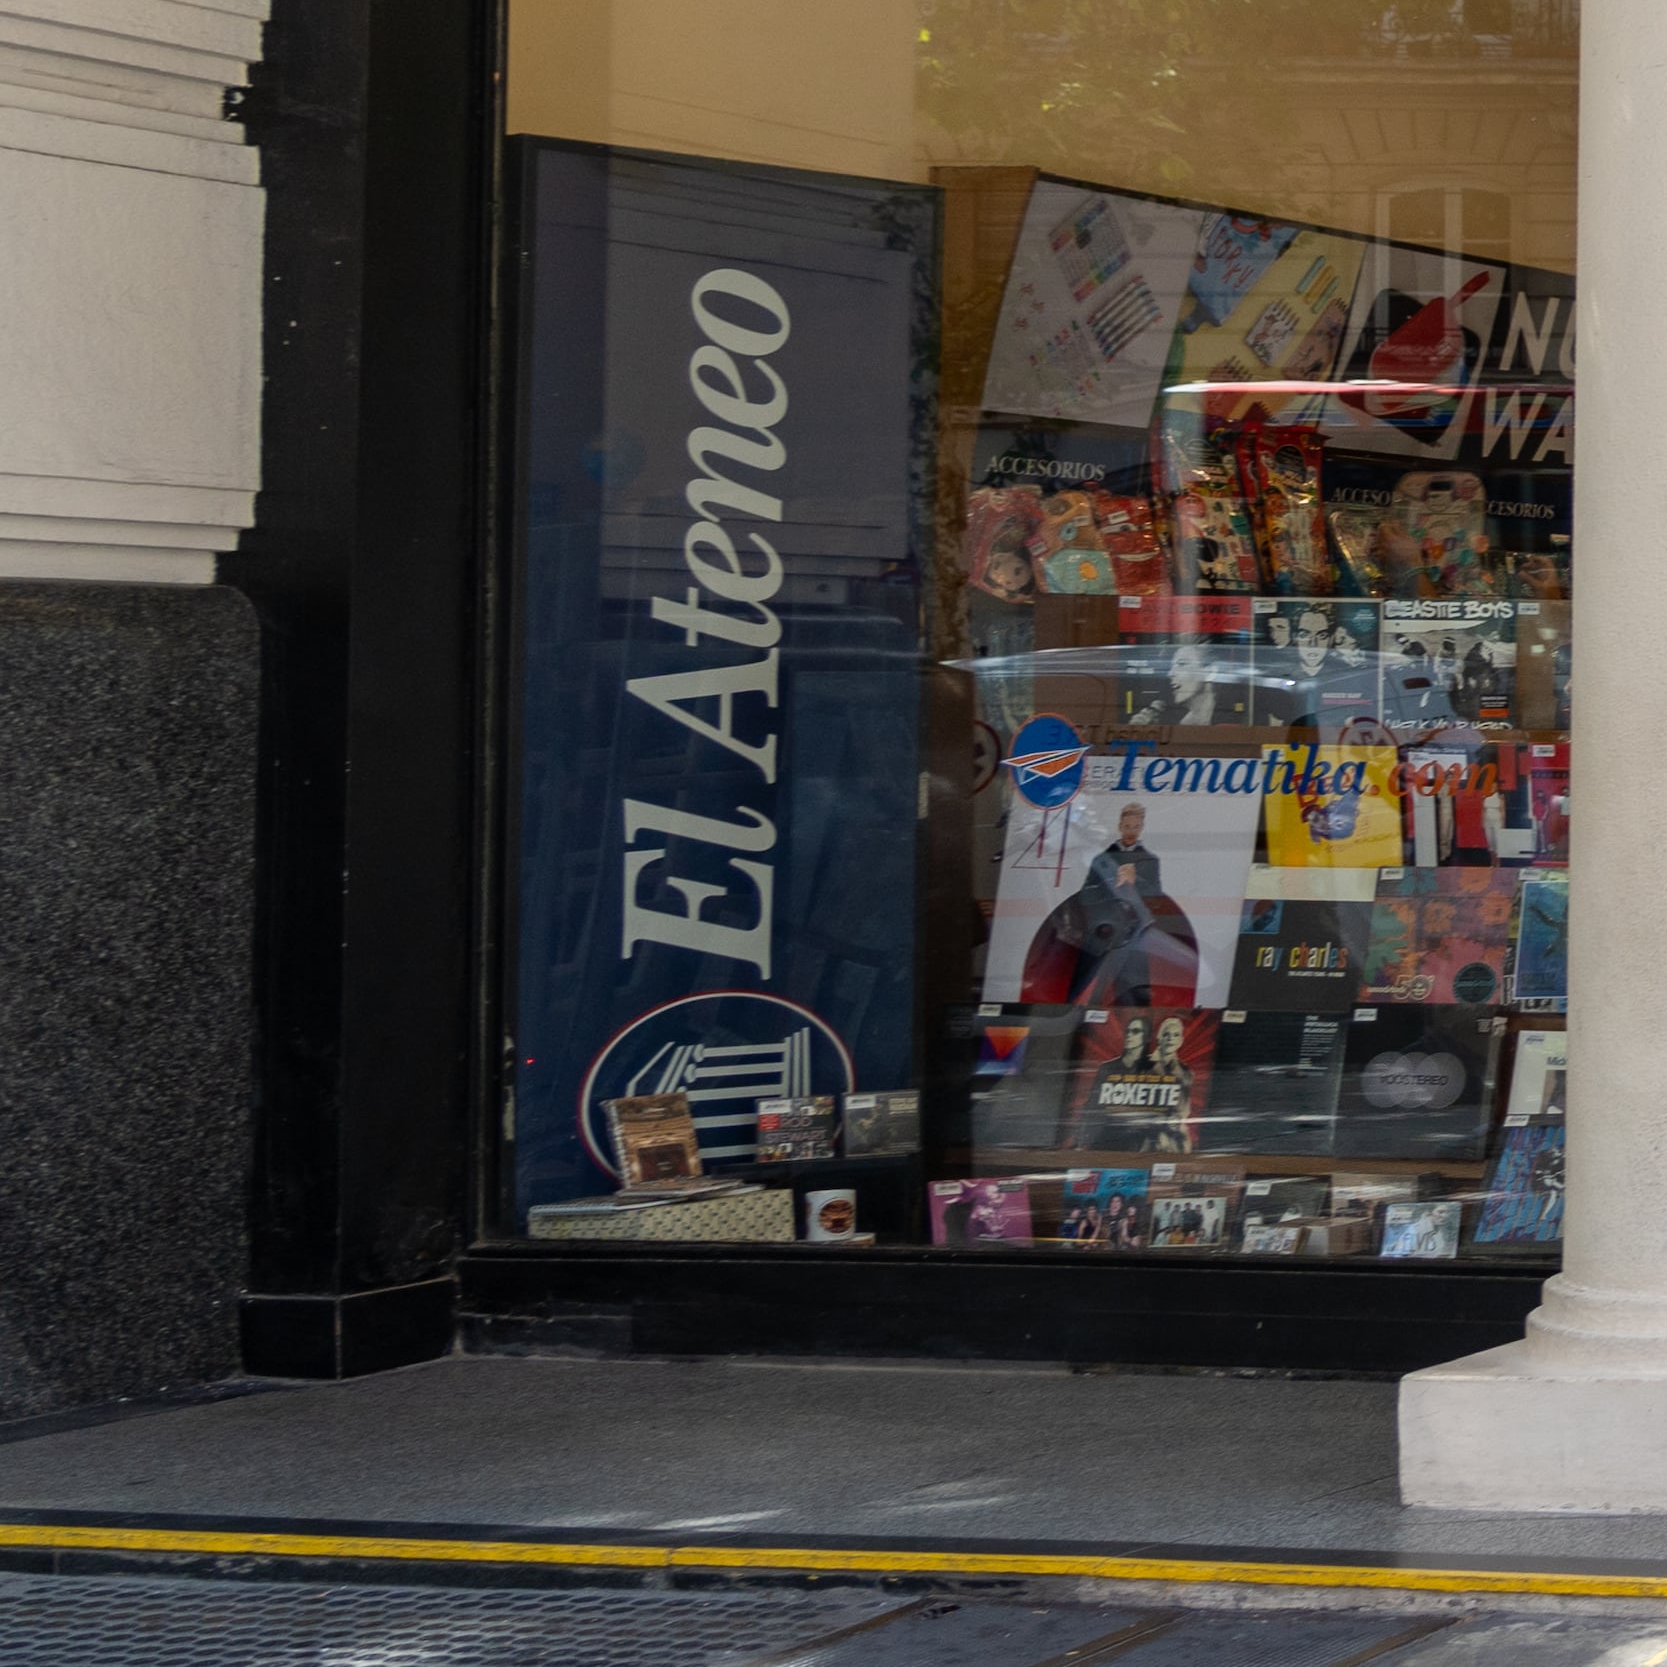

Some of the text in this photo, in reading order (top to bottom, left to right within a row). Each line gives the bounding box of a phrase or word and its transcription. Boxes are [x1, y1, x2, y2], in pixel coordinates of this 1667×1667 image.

[984, 455, 1106, 481] ACCESORIOS
[1330, 487, 1393, 507] ACCESO
[1484, 499, 1556, 521] CCESORIOS
[1385, 599, 1514, 619] BEASTIE BOYS
[622, 268, 792, 981] El Ateneo
[1255, 941, 1348, 973] ray charles
[1098, 1081, 1182, 1107] ROXETTE
[780, 1117, 812, 1128] ROD
[765, 1130, 826, 1142] STEWART
